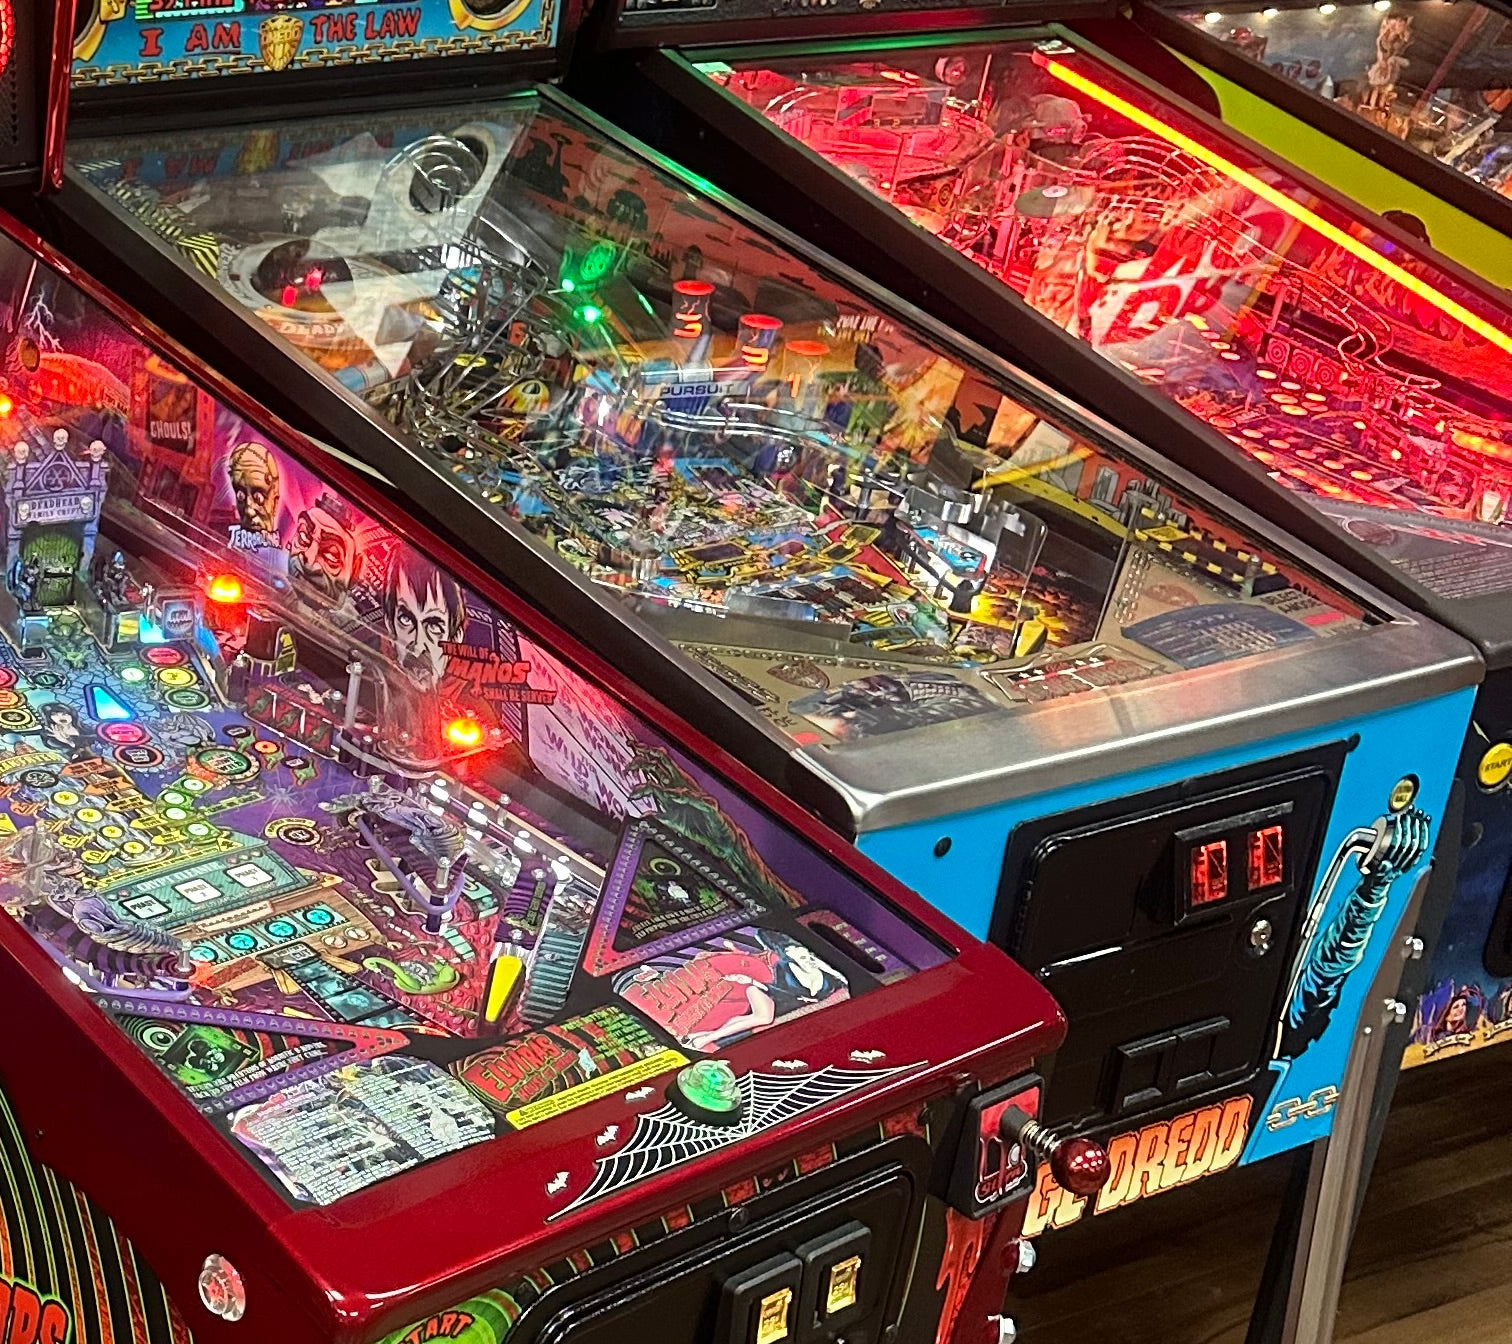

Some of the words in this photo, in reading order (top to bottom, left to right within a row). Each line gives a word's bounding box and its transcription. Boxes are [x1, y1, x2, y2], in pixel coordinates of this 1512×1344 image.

[141, 28, 164, 56] I
[186, 22, 240, 51] AM
[312, 11, 357, 44] THE
[365, 7, 421, 40] LAW
[661, 384, 735, 397] PURSUIT
[150, 420, 194, 441] GHOULS!
[441, 642, 456, 655] THE
[457, 645, 476, 657] WILL
[448, 656, 531, 684] MANOS
[1094, 1093, 1254, 1216] DREDD
